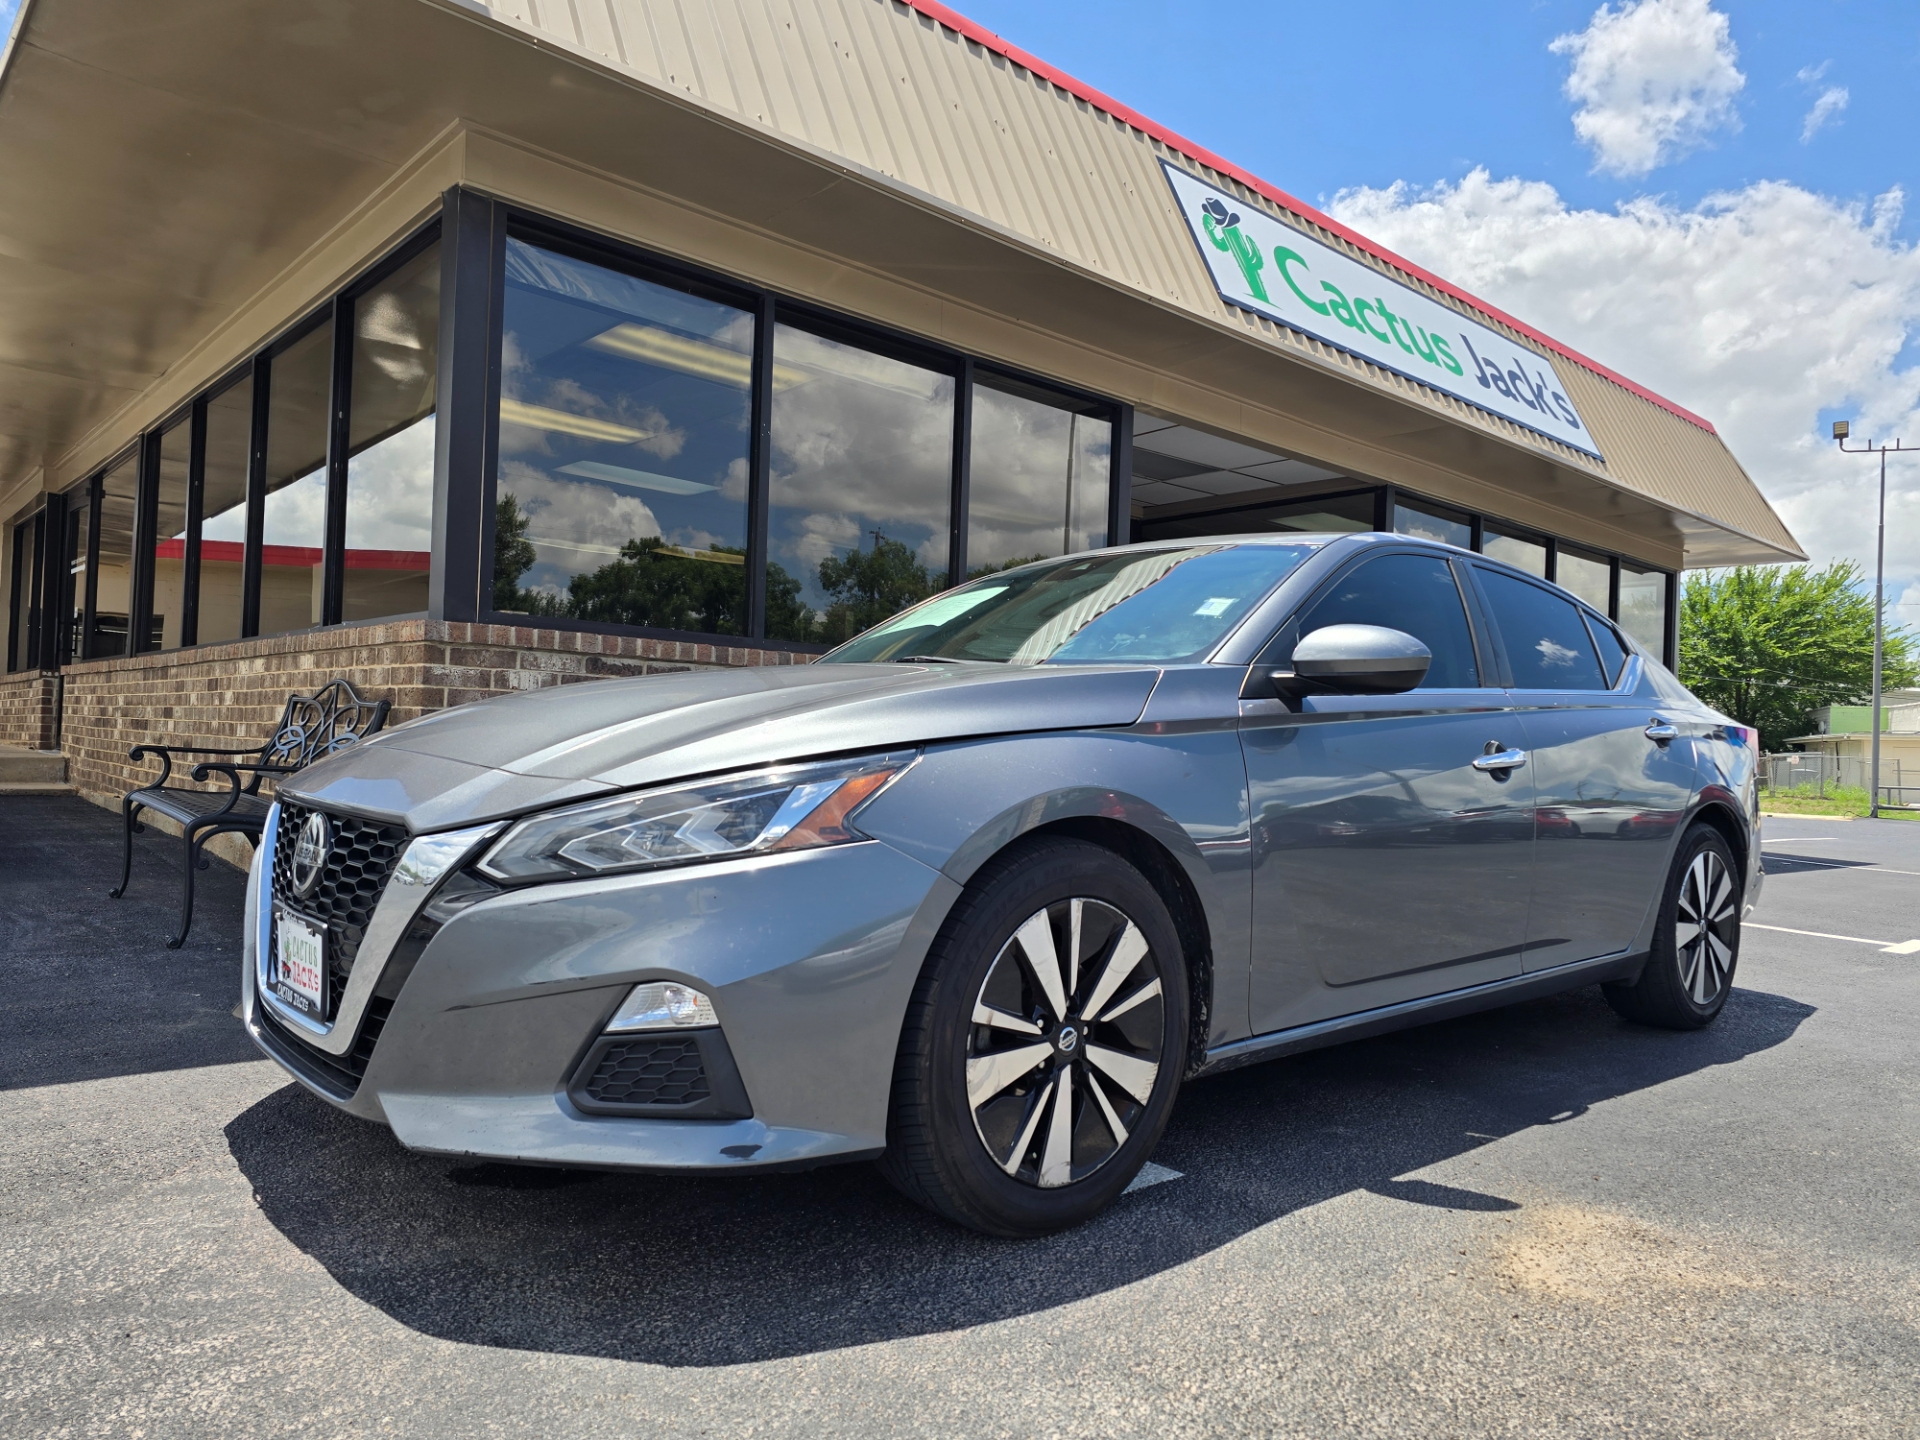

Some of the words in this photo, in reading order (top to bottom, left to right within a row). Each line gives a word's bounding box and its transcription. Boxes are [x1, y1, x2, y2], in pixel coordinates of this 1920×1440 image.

[1273, 245, 1464, 377] Cactus
[1459, 333, 1581, 430] Jack's
[292, 935, 318, 968] CACTUS
